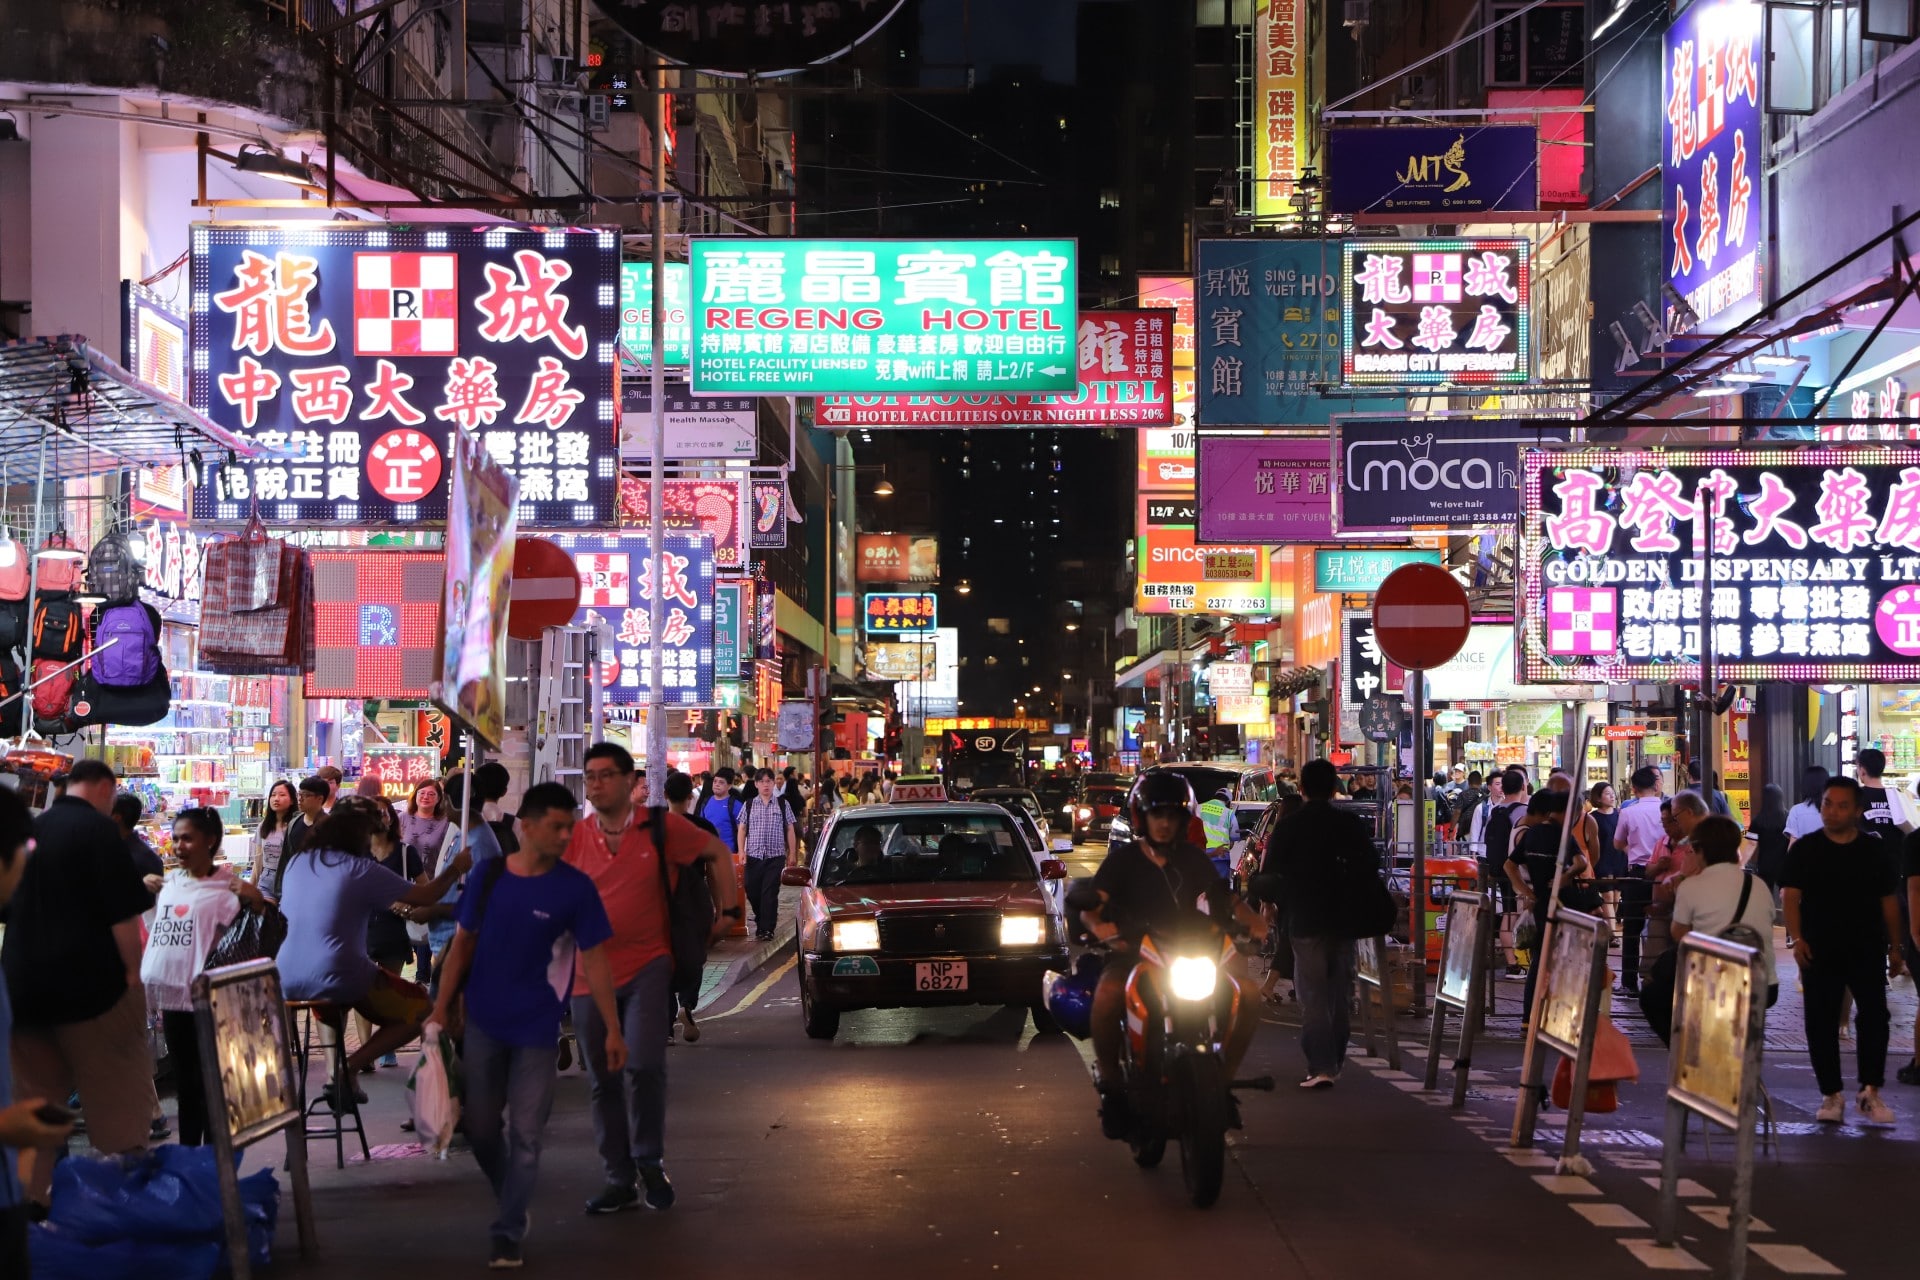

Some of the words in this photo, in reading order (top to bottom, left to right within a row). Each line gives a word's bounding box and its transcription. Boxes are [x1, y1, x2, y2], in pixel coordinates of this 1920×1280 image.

[702, 250, 1069, 306] 麗晶賓館
[1265, 270, 1296, 281] SING
[1353, 254, 1412, 305] 龍
[1463, 252, 1518, 304] 城
[1265, 285, 1296, 296] YUET
[213, 249, 337, 356] 龍
[475, 249, 588, 360] 城
[706, 308, 884, 330] REGENG
[922, 308, 1062, 330] HOTEL
[1361, 304, 1511, 352] 大藥房
[701, 359, 746, 369] HOTEL
[749, 359, 808, 369] FACILITY
[1409, 353, 1439, 371] CITY
[701, 372, 746, 382] HOTEL
[749, 372, 780, 382] FREE
[783, 372, 813, 382] WIFI
[219, 356, 585, 431] 中西大藥房
[856, 410, 908, 422] HOTEL
[911, 410, 997, 422] FACILITEIS
[1001, 410, 1043, 421] OVER
[1046, 409, 1097, 422] NIGHT
[1100, 409, 1138, 420] LESS
[1141, 409, 1164, 420] 20%
[736, 440, 751, 448] 1/F
[384, 459, 424, 496] 正
[1150, 507, 1174, 517] 12/F
[1390, 513, 1449, 523] appointment
[1546, 559, 1669, 581] GOLDEN
[1680, 559, 1870, 581] DSPENSARY
[1143, 585, 1194, 596] 租務熱線
[1170, 599, 1194, 609] TEL:
[1208, 599, 1233, 608] 2377
[1240, 599, 1266, 608] 2263
[894, 786, 942, 798] TAXI
[161, 904, 173, 920] I
[154, 920, 193, 934] HONG
[152, 933, 192, 947] KONG
[852, 960, 860, 969] 5
[931, 963, 952, 976] NP
[920, 976, 964, 990] 6827
